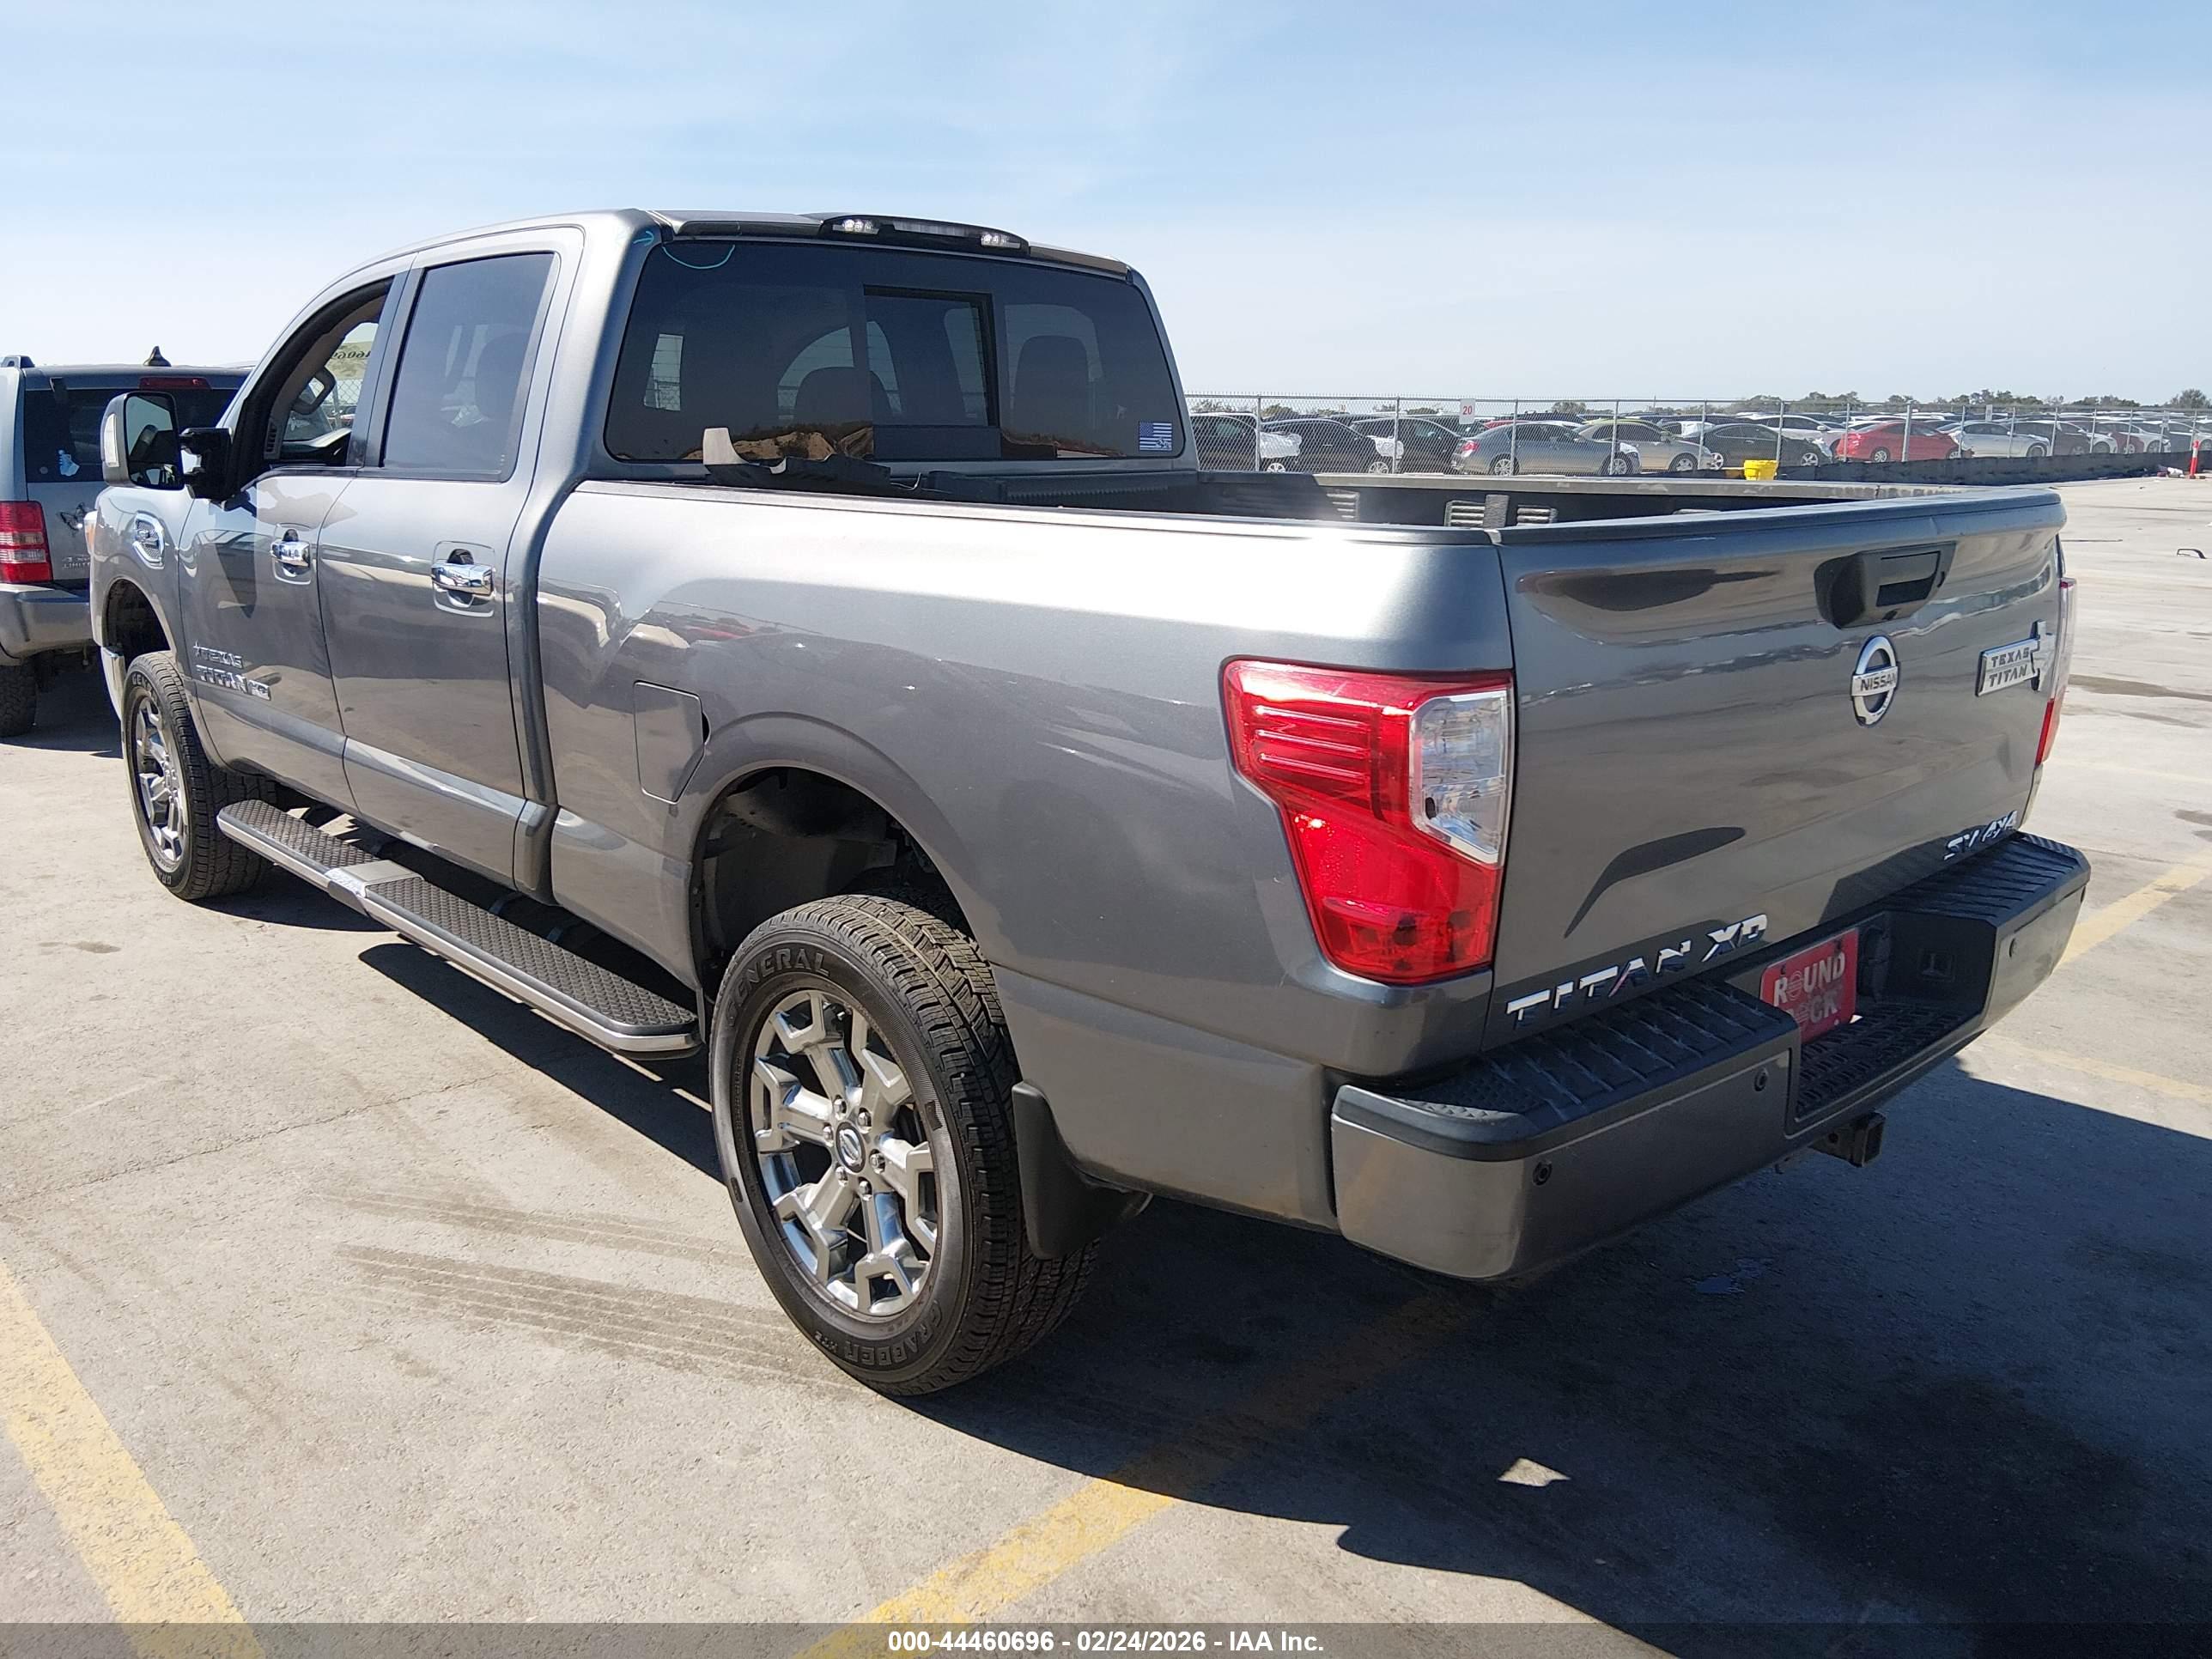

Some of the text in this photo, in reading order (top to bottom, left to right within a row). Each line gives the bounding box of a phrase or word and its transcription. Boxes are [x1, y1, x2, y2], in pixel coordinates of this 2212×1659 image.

[1462, 405, 1473, 415] 20
[1991, 647, 2030, 668] TEXAS
[196, 665, 247, 694] TITAN
[1860, 672, 1896, 691] NISSAN
[1989, 664, 2027, 688] TITAN
[1943, 830, 1980, 860] SV
[1505, 913, 1768, 1027] TITAN XD
[1773, 951, 1845, 1007] ROUND
[726, 947, 830, 1027] GENERAL
[1787, 989, 1839, 1024] OCK
[844, 1299, 944, 1366] GRABBER
